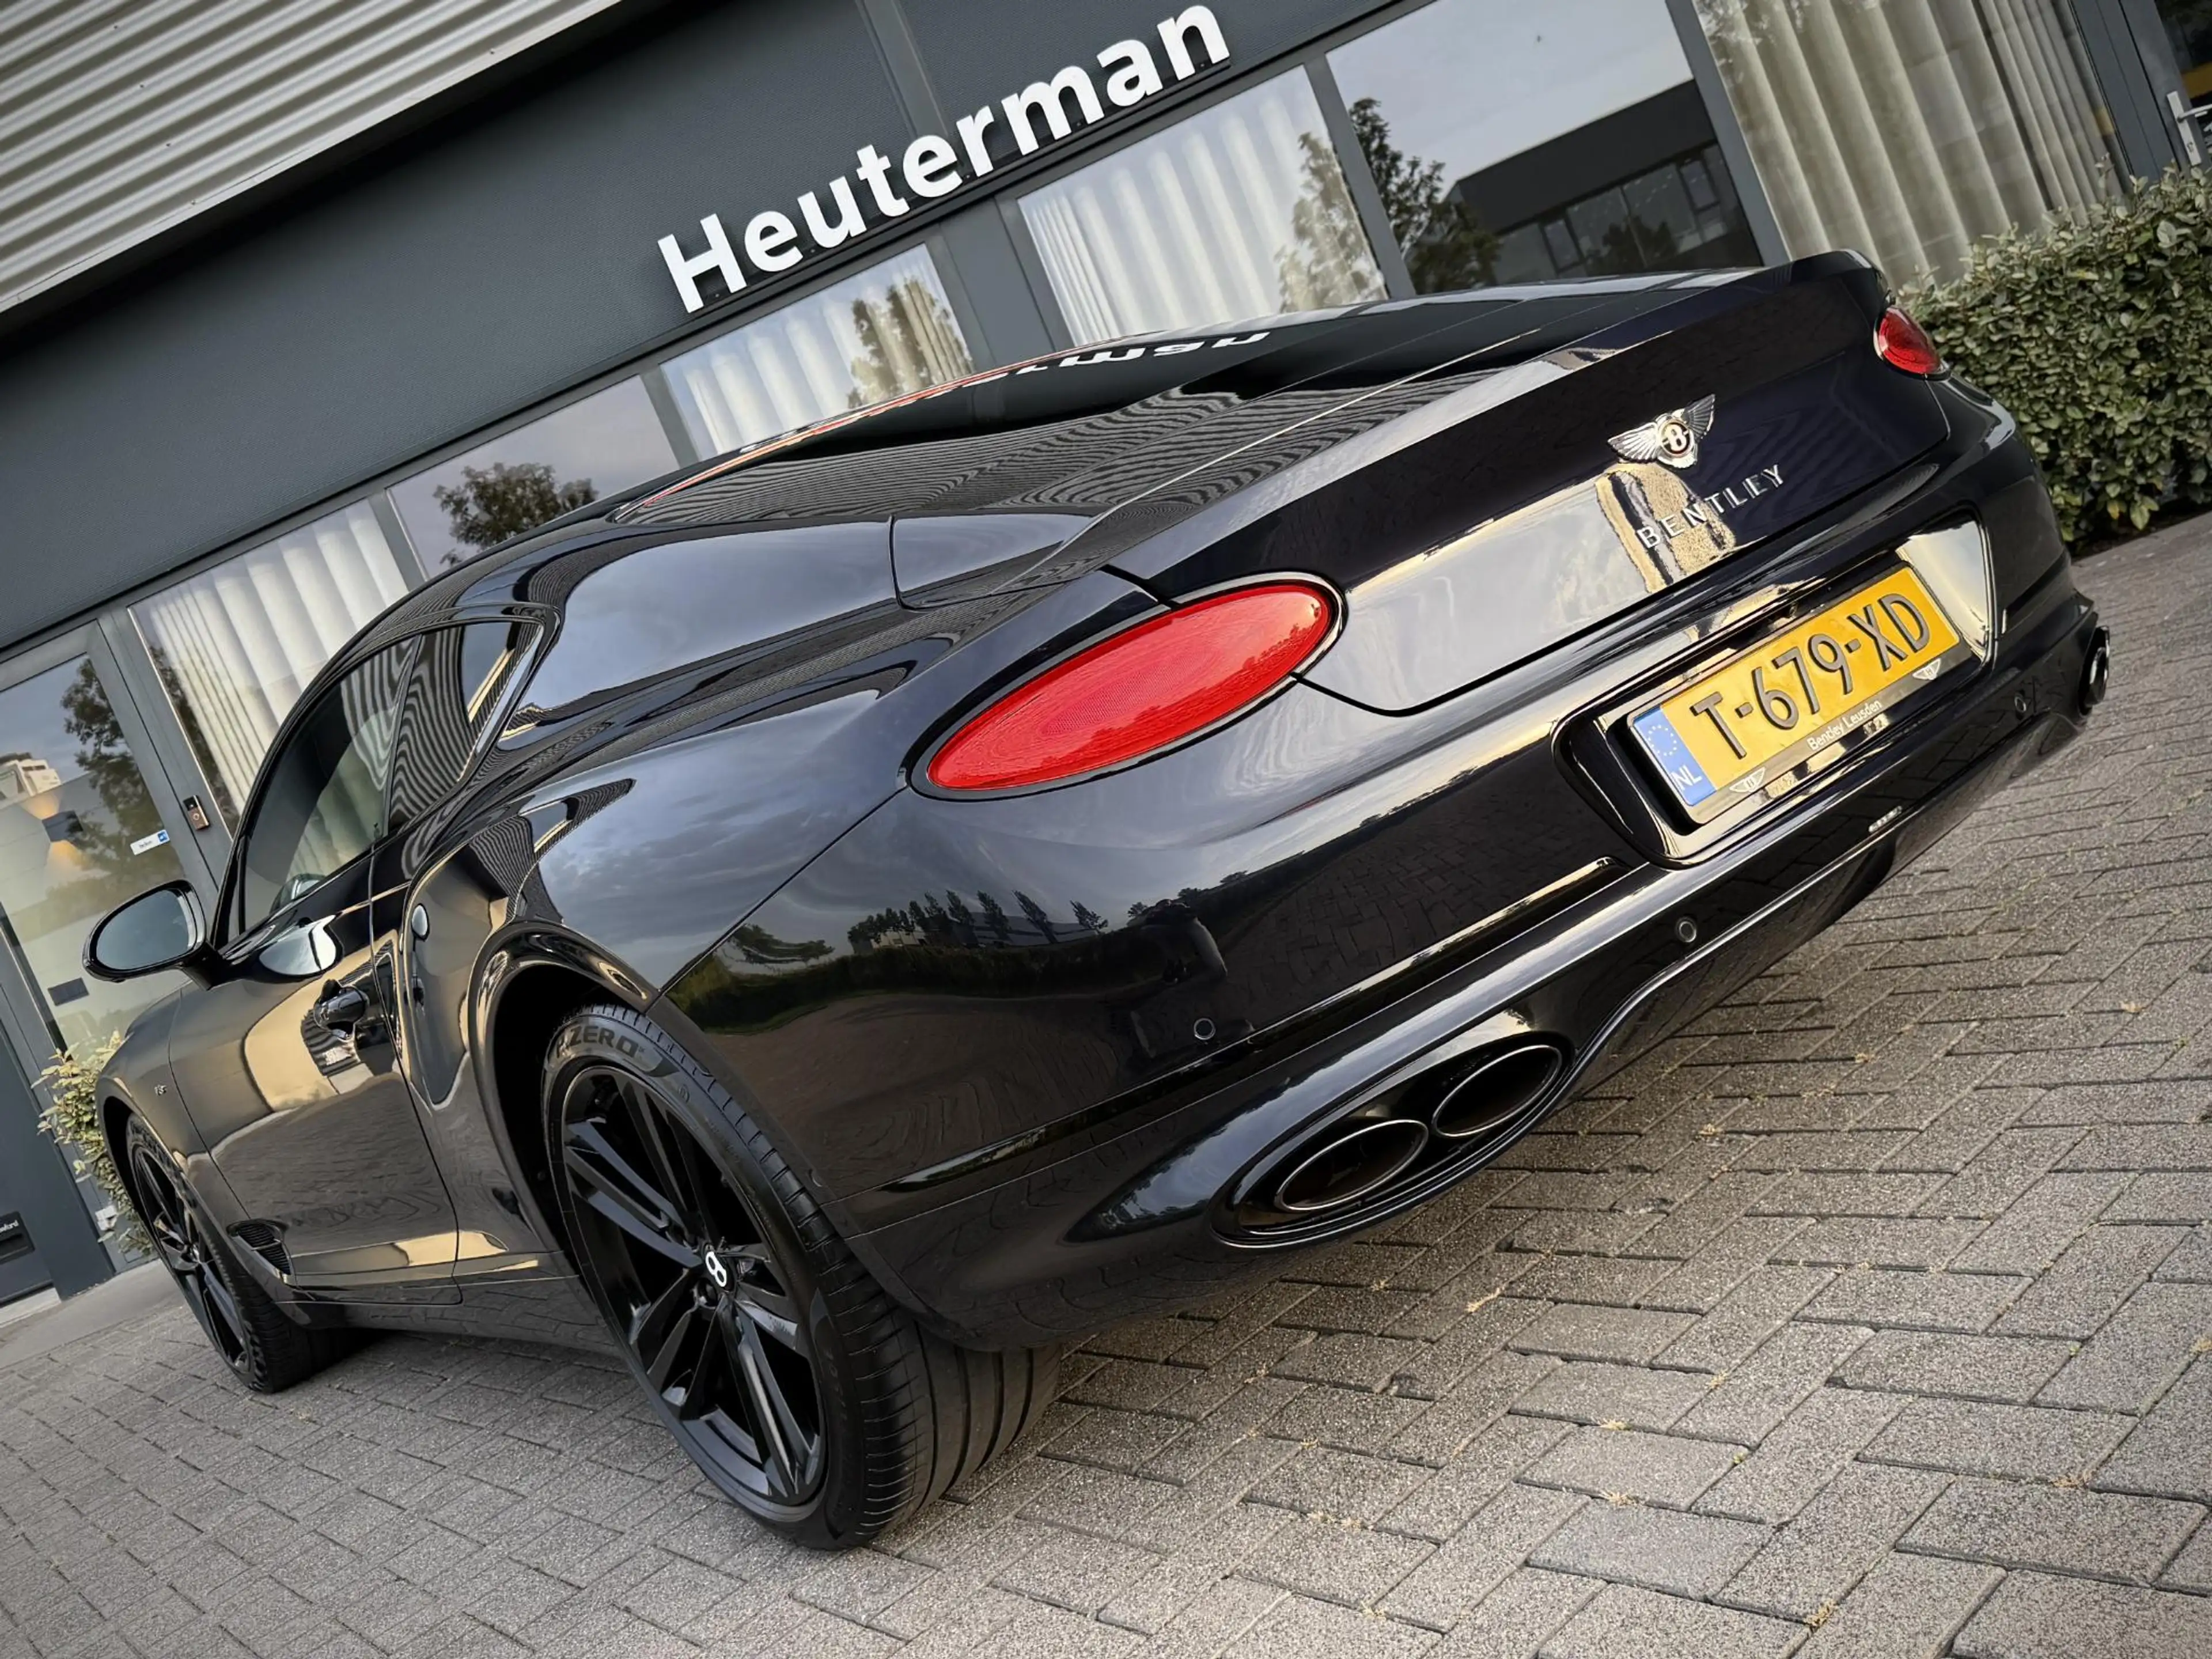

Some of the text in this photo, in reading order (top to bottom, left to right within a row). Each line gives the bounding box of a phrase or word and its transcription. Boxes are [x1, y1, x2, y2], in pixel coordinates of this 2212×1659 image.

[658, 5, 1230, 312] Heuterman
[1637, 464, 1785, 549] BENTLEY
[1690, 594, 1929, 759] T-679-XD
[1842, 700, 1883, 728] Leusden
[1669, 764, 1703, 791] NL
[569, 1025, 639, 1058] ZERO
